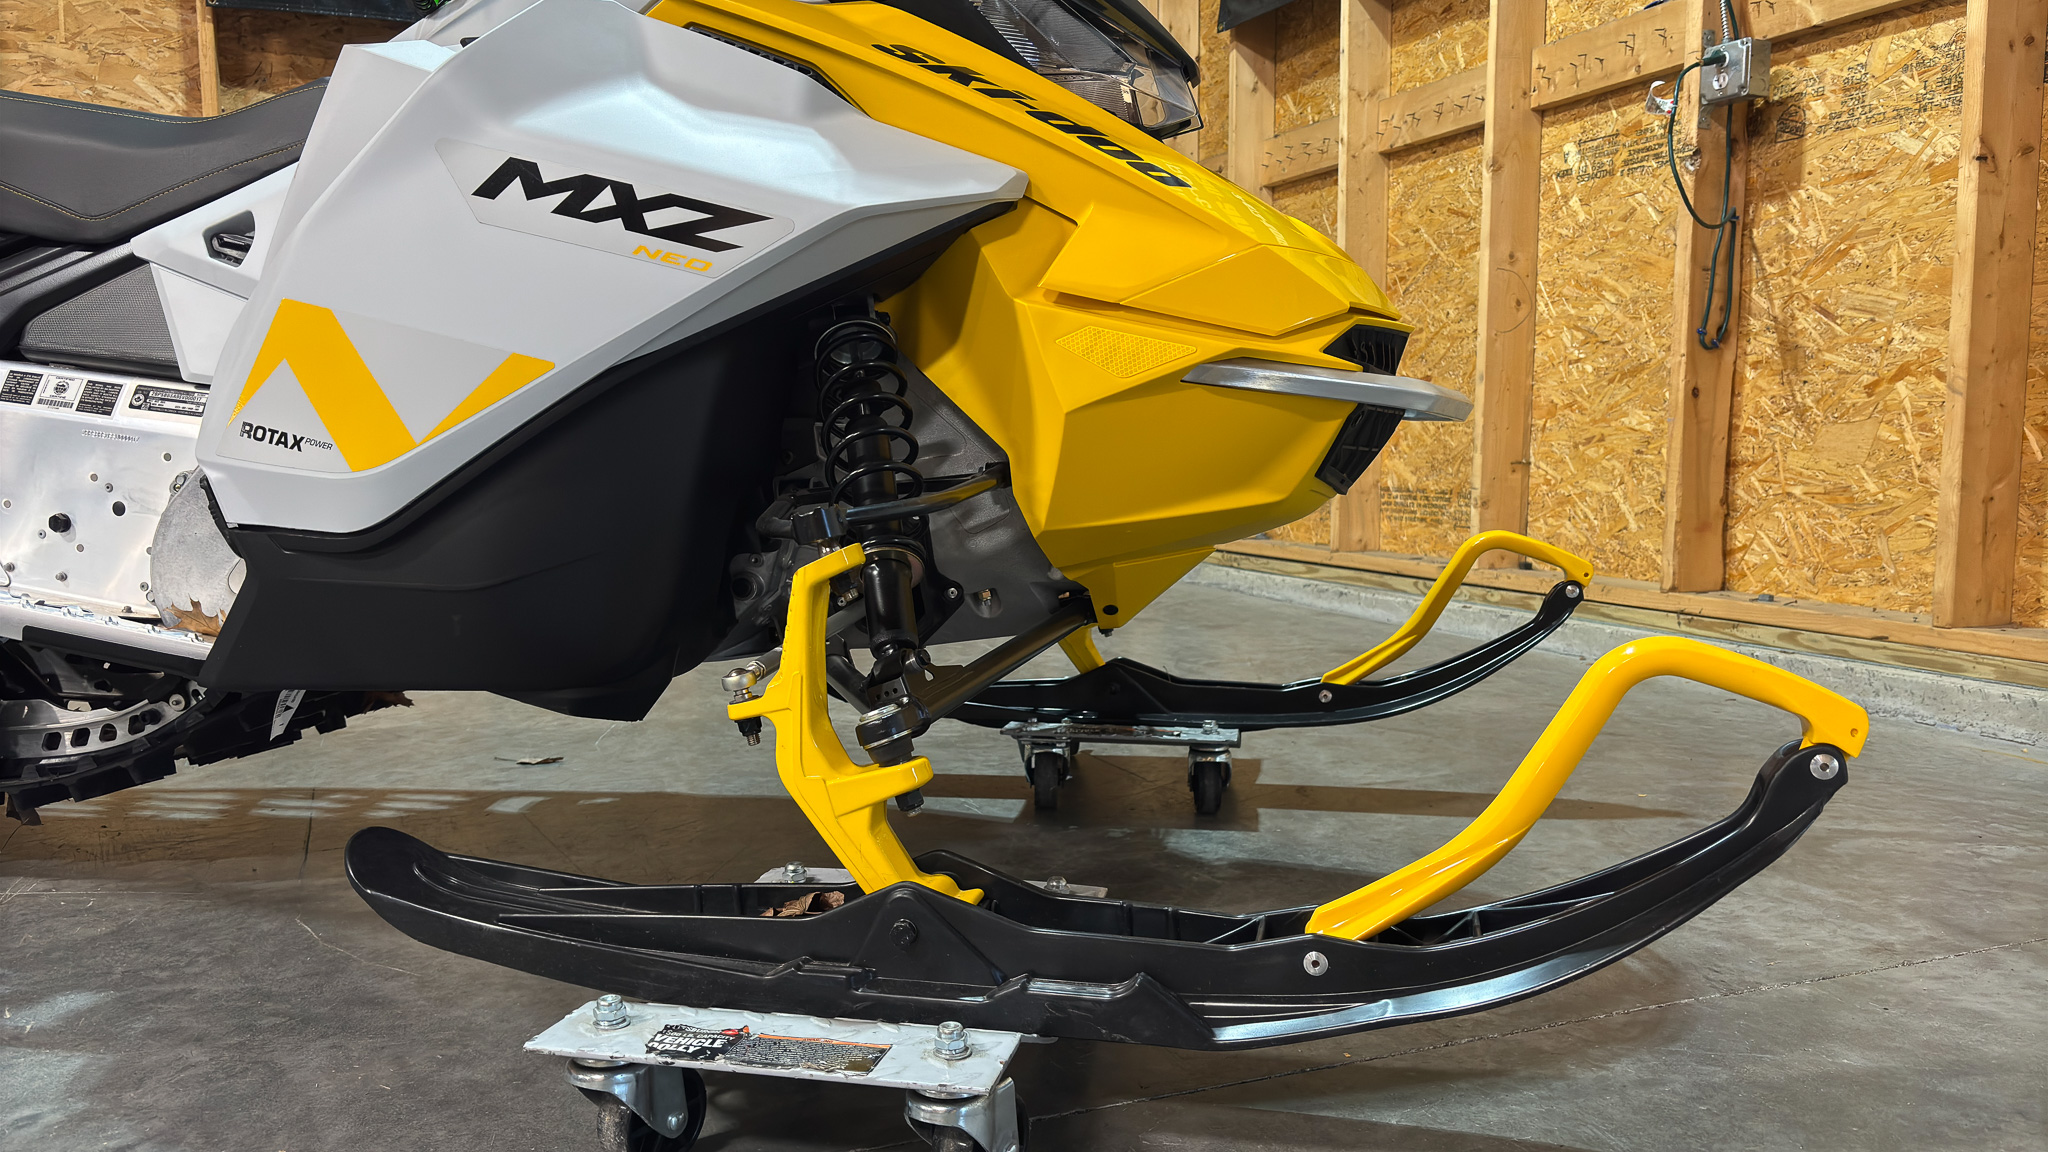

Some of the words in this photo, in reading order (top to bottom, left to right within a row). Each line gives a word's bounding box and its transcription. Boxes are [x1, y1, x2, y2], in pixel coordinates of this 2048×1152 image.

[471, 156, 774, 253] MXZ
[632, 244, 713, 272] NEO
[239, 421, 305, 452] ROTAX
[304, 437, 334, 451] POWER
[653, 1033, 728, 1048] VEHICLE
[697, 1033, 735, 1041] CAPACITY
